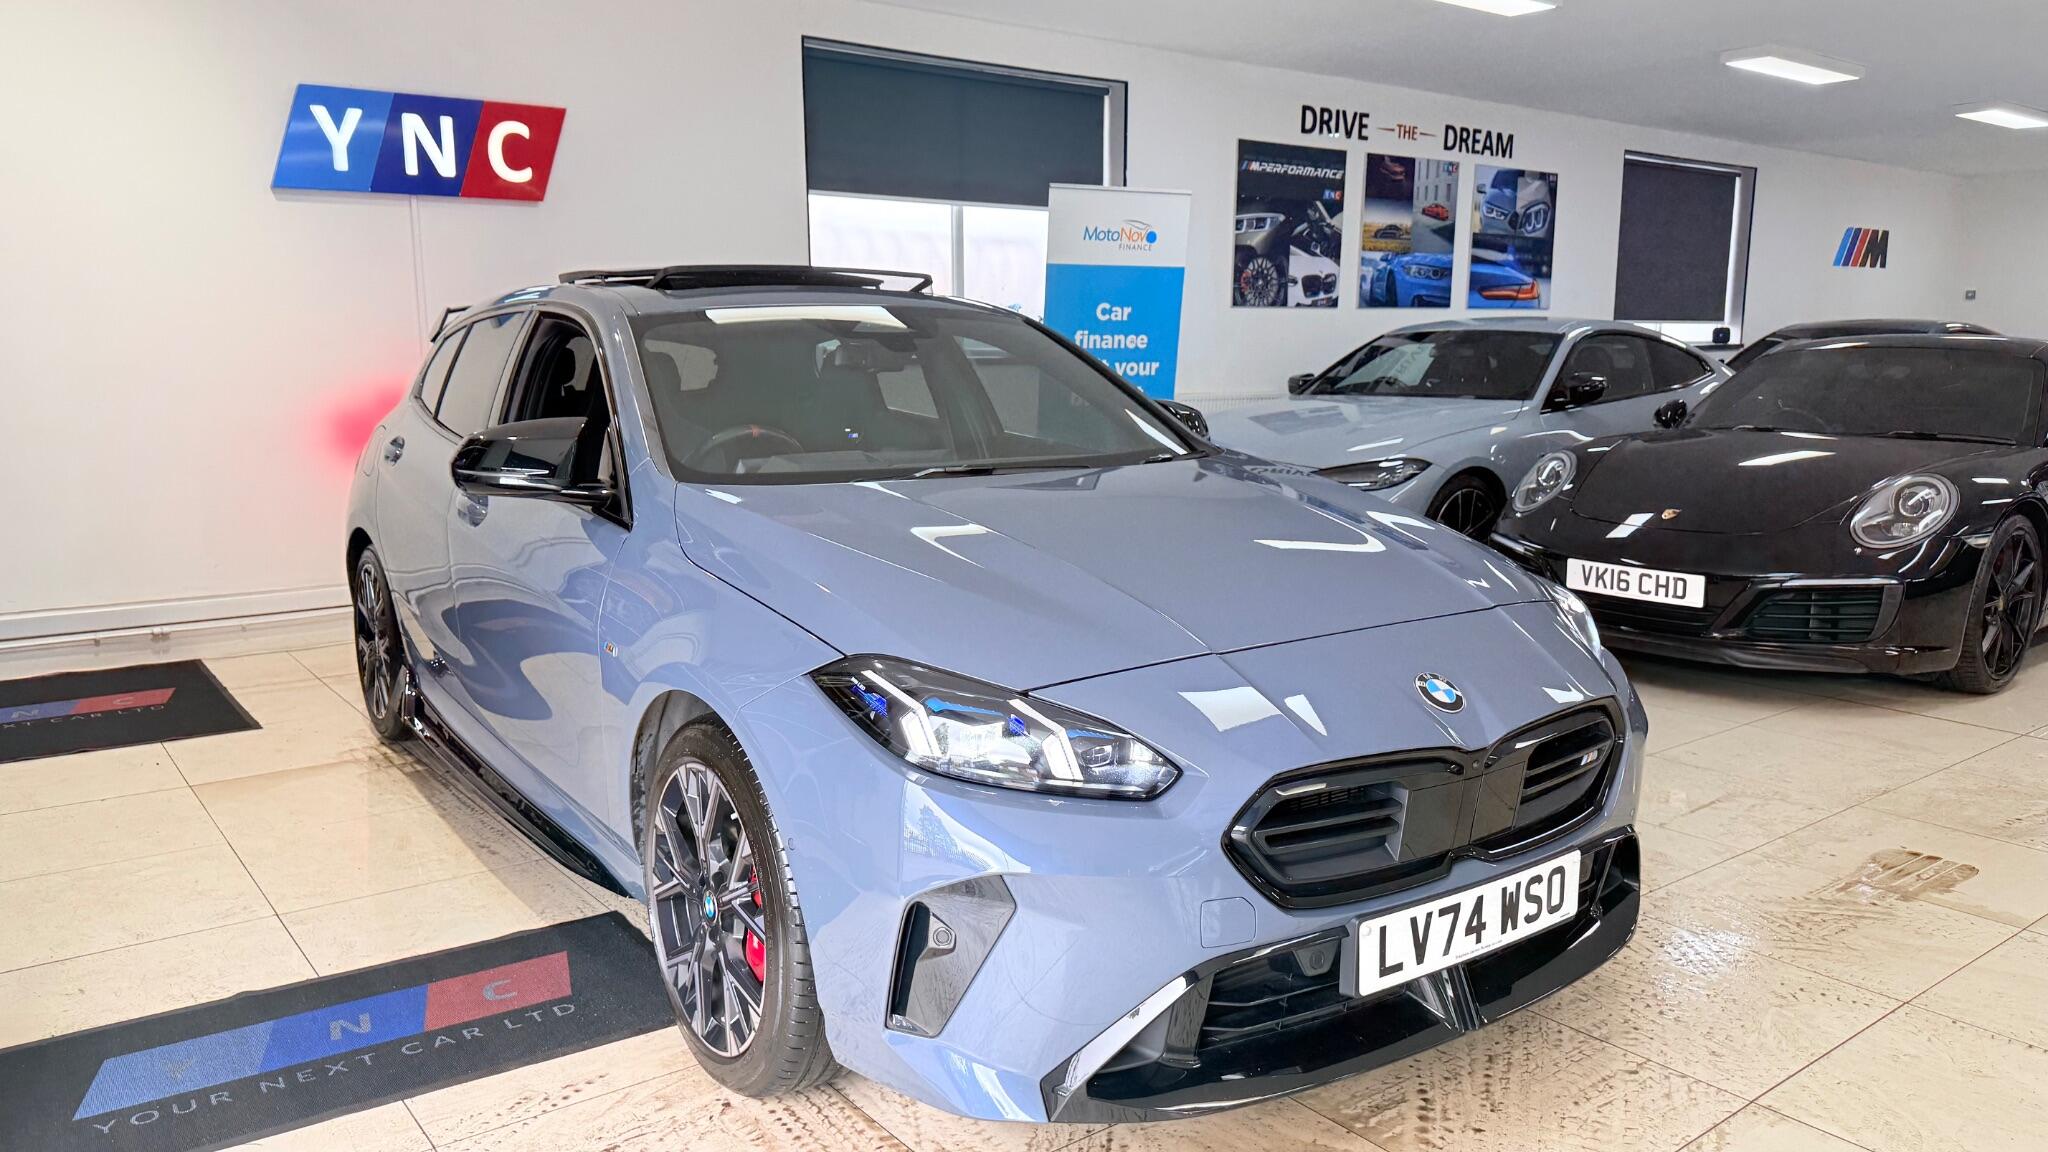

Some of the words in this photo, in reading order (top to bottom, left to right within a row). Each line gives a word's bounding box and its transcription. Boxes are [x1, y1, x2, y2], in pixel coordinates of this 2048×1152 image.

[309, 103, 533, 183] YNC
[1300, 104, 1370, 141] DRIVE
[1396, 123, 1418, 141] THE
[1443, 124, 1514, 159] DREAM
[1119, 243, 1152, 251] FINANCE
[1096, 303, 1132, 321] Car
[1075, 331, 1148, 349] finance
[1114, 361, 1160, 377] your
[1582, 564, 1630, 593] VK16
[1638, 572, 1688, 600] CHD
[1378, 894, 1487, 979] LV74
[1500, 865, 1567, 936] WSO
[93, 1090, 233, 1135] YOUR
[260, 1053, 375, 1095] NEXT
[400, 1027, 484, 1056] CAR
[503, 1004, 577, 1031] LTD
